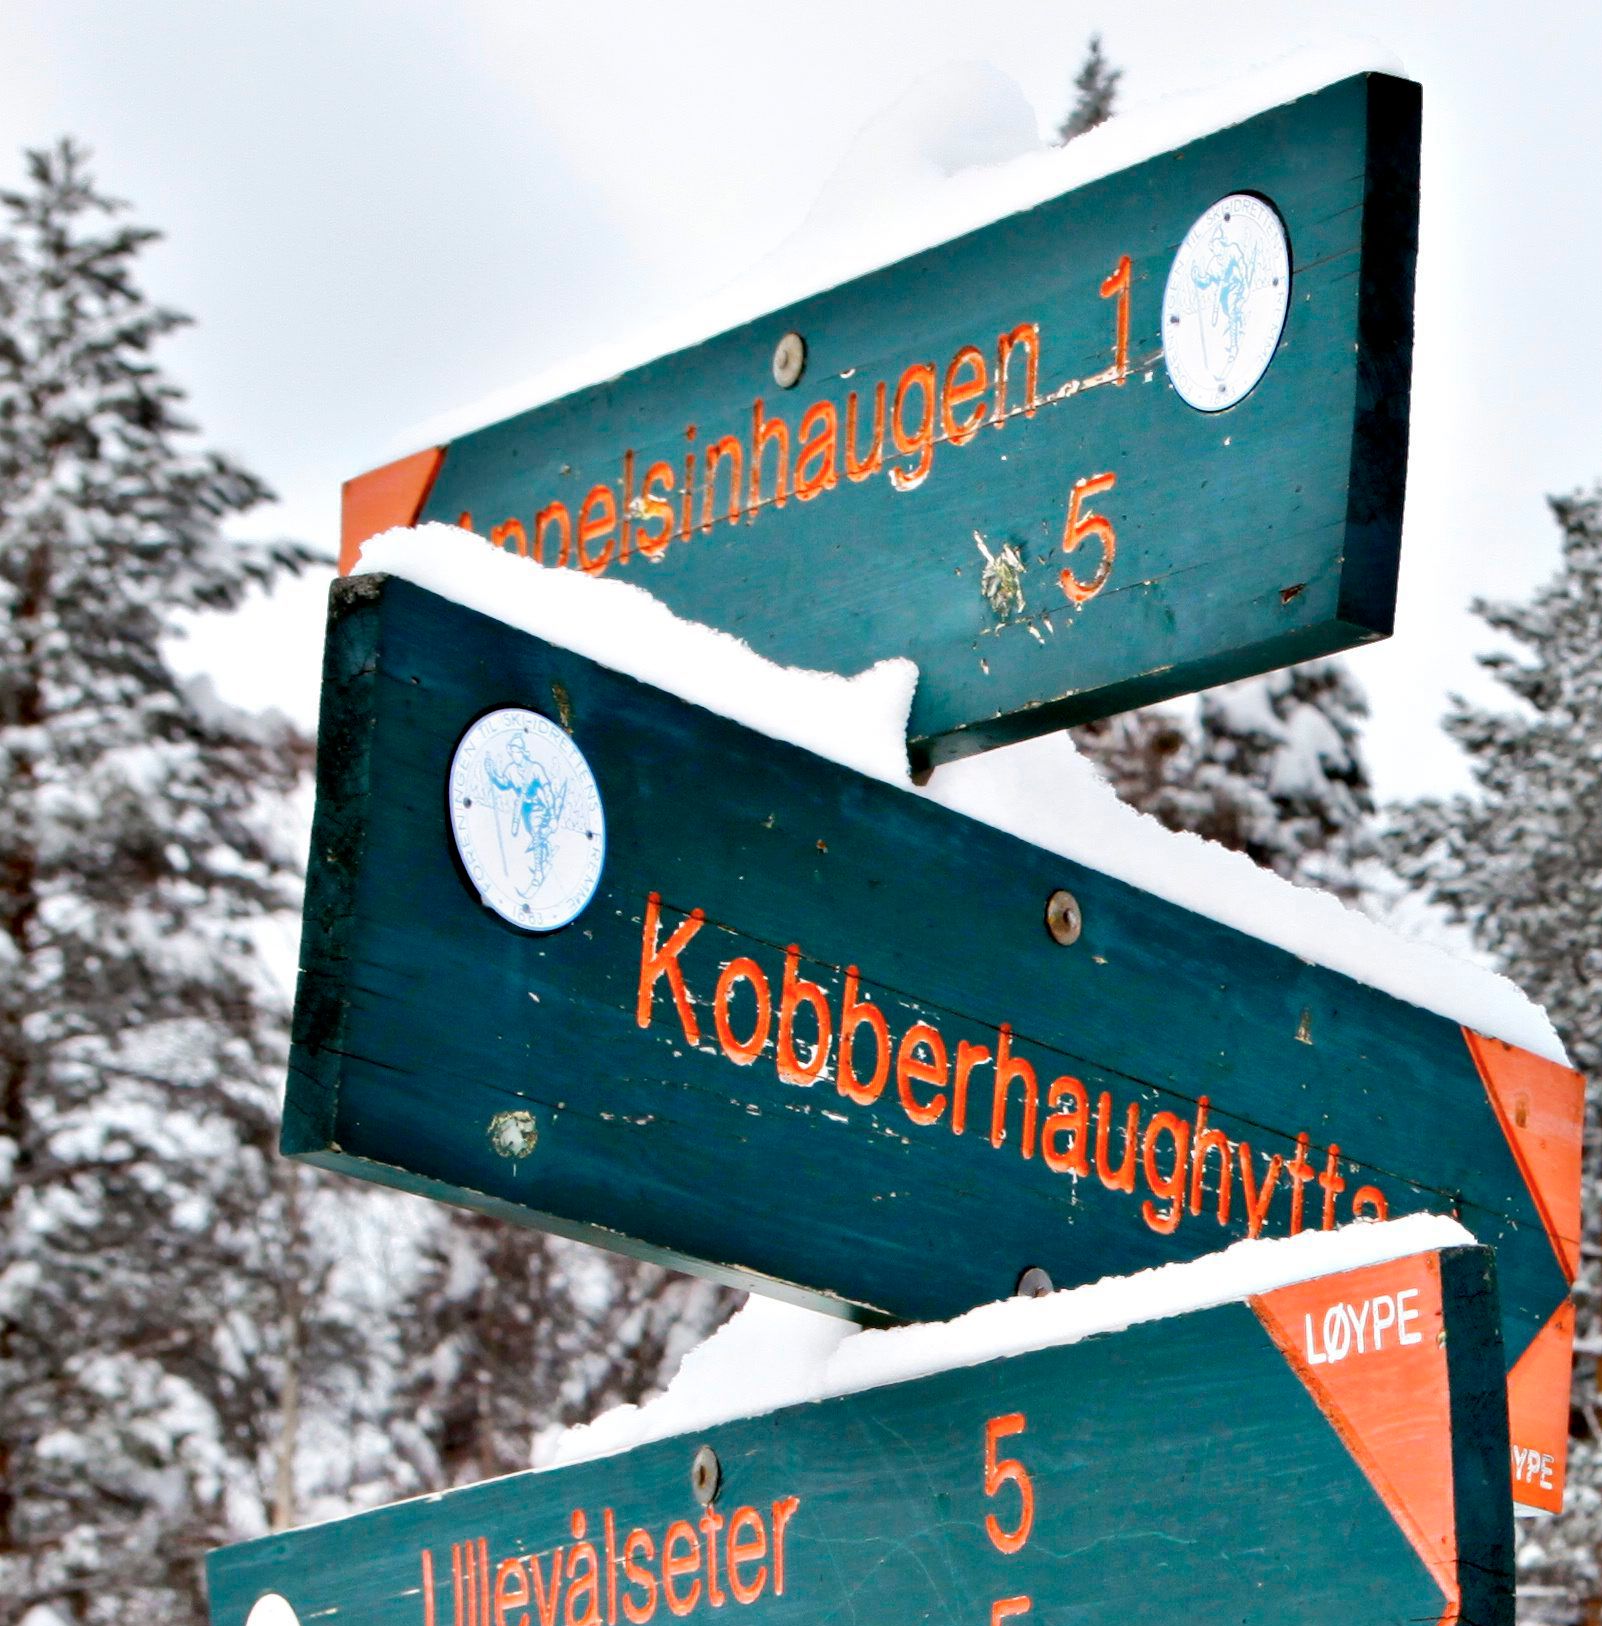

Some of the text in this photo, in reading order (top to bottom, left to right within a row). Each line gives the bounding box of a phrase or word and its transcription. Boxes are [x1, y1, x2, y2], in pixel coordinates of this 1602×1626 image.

[456, 255, 1132, 578] pelsinhaugen 1
[1058, 470, 1117, 606] 5
[479, 723, 498, 740] TIL
[1304, 1288, 1423, 1365] LØYPE
[984, 1411, 1036, 1554] 5
